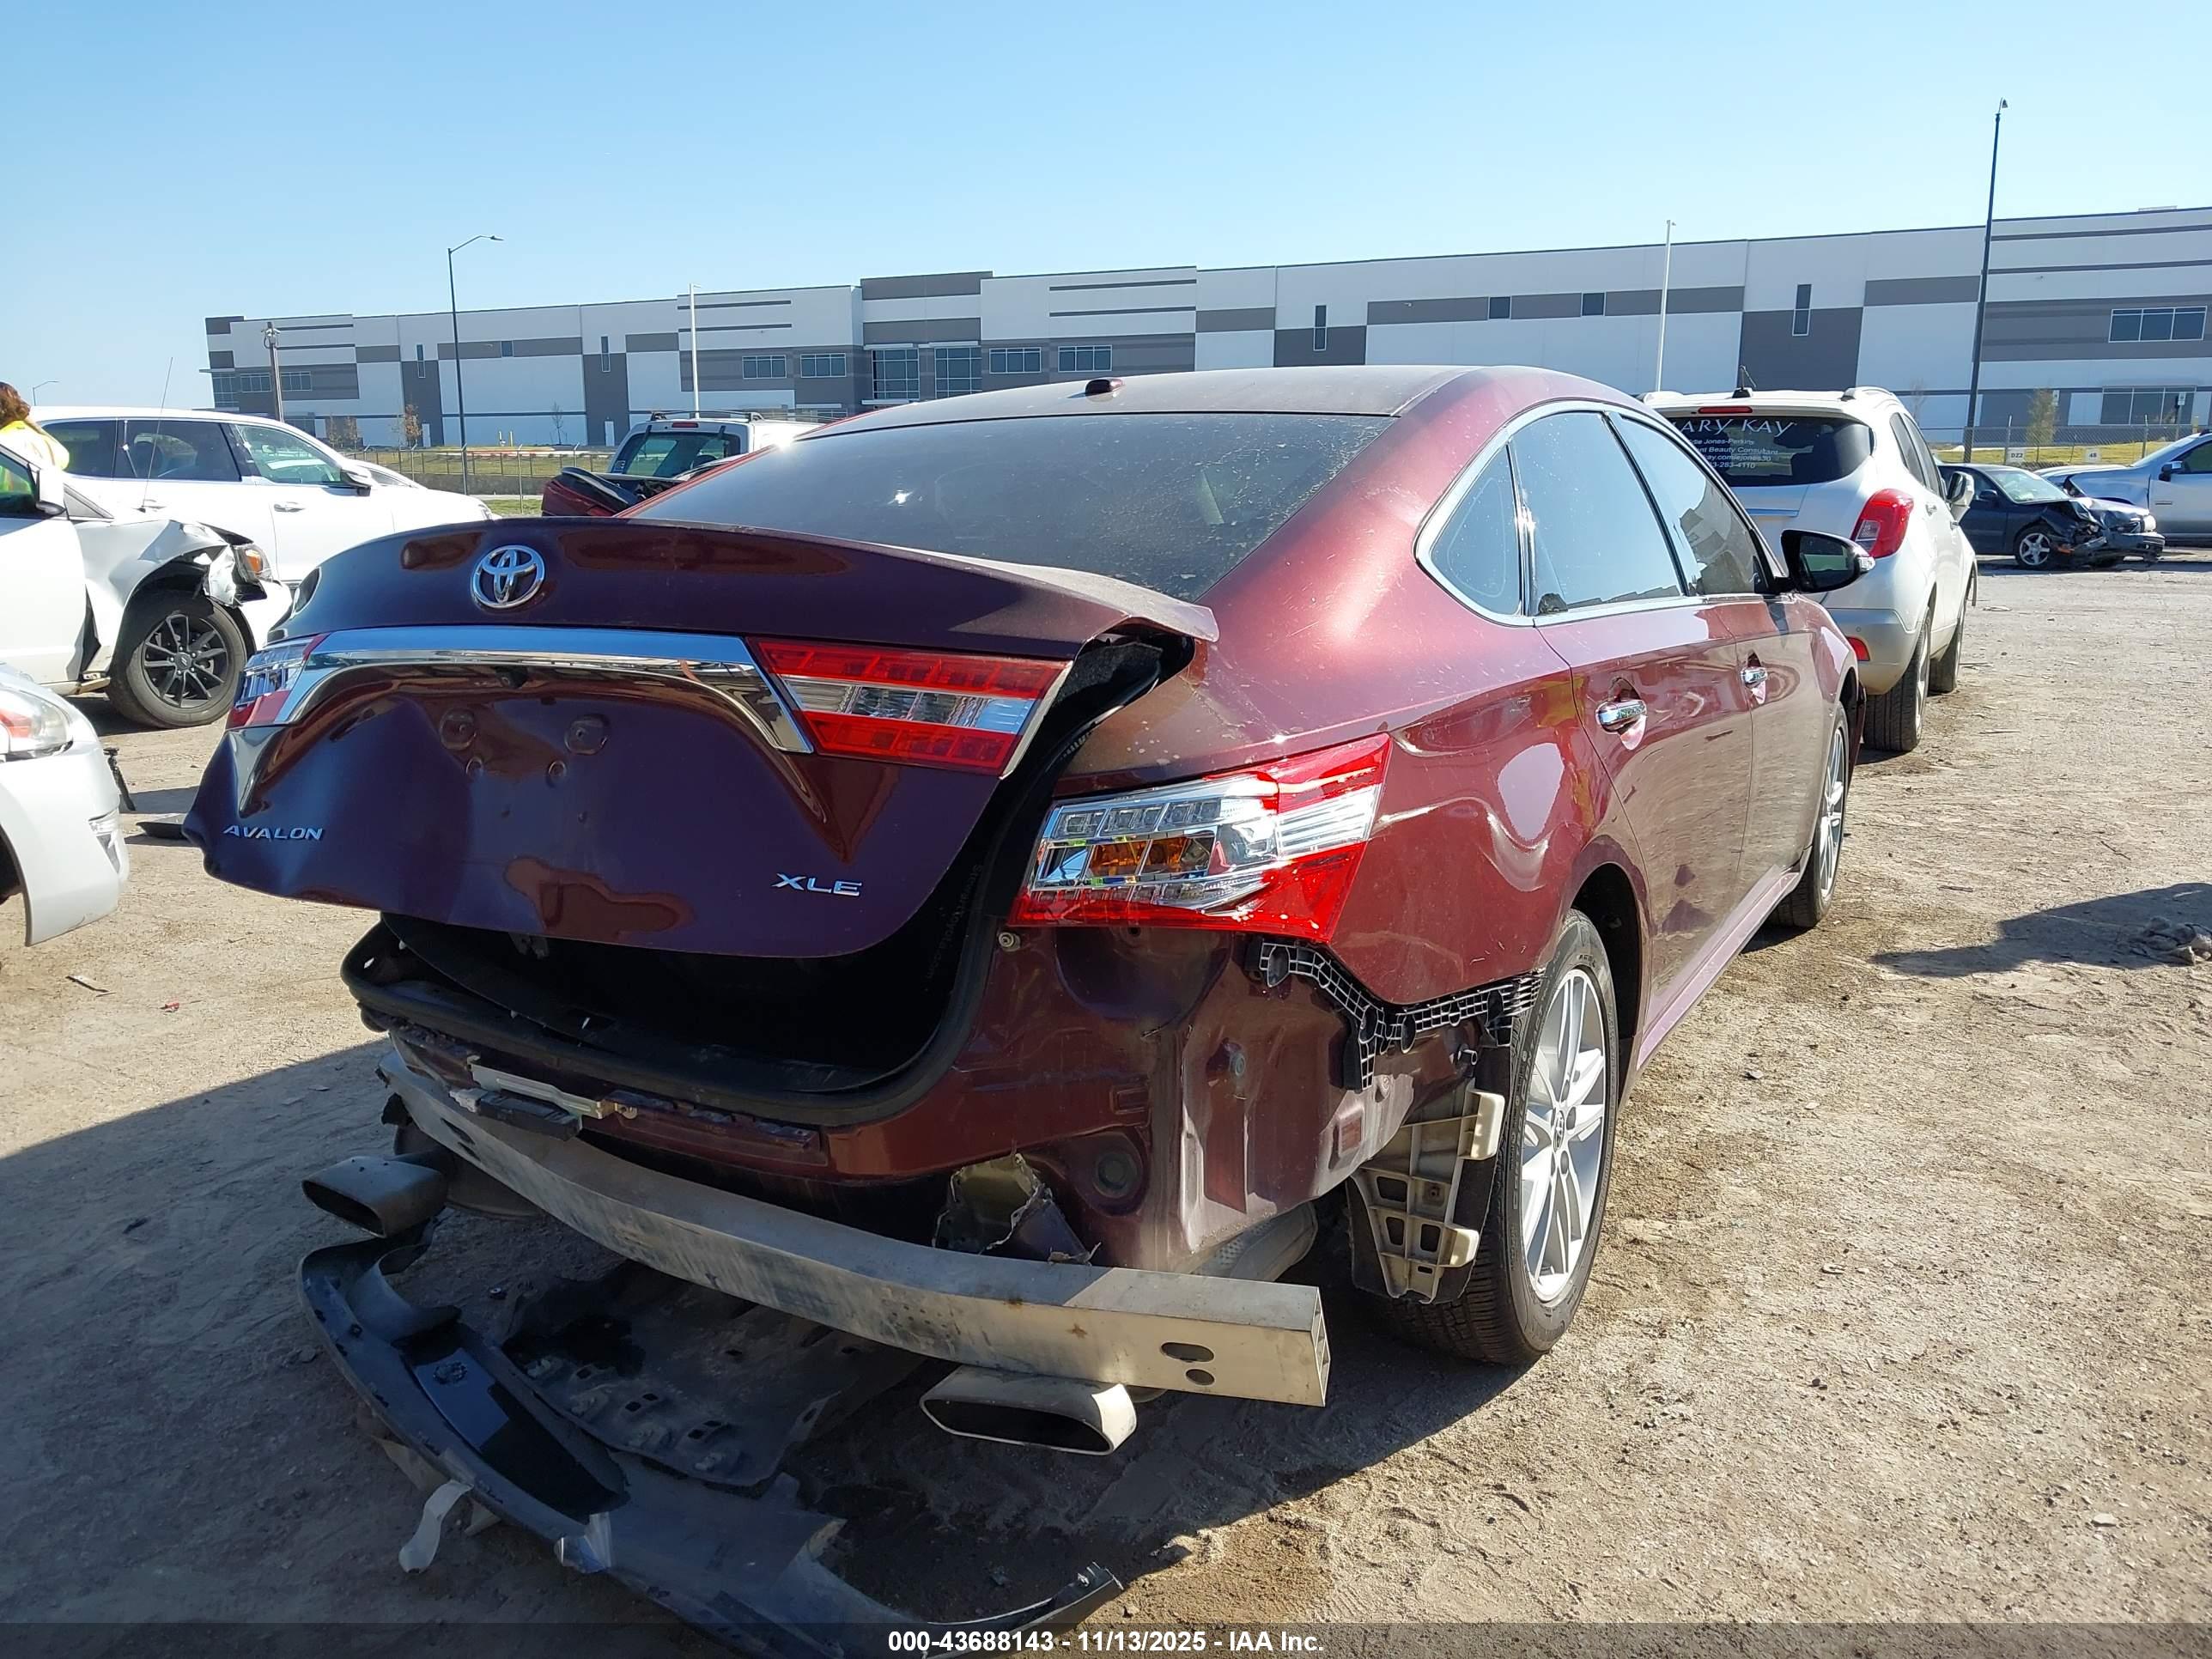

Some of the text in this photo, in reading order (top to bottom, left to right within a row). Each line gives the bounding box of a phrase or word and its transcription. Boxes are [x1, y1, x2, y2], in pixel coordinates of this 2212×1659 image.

[1674, 419, 1796, 437] ARY KAY
[222, 824, 324, 841] AVALON
[771, 872, 863, 896] XLE
